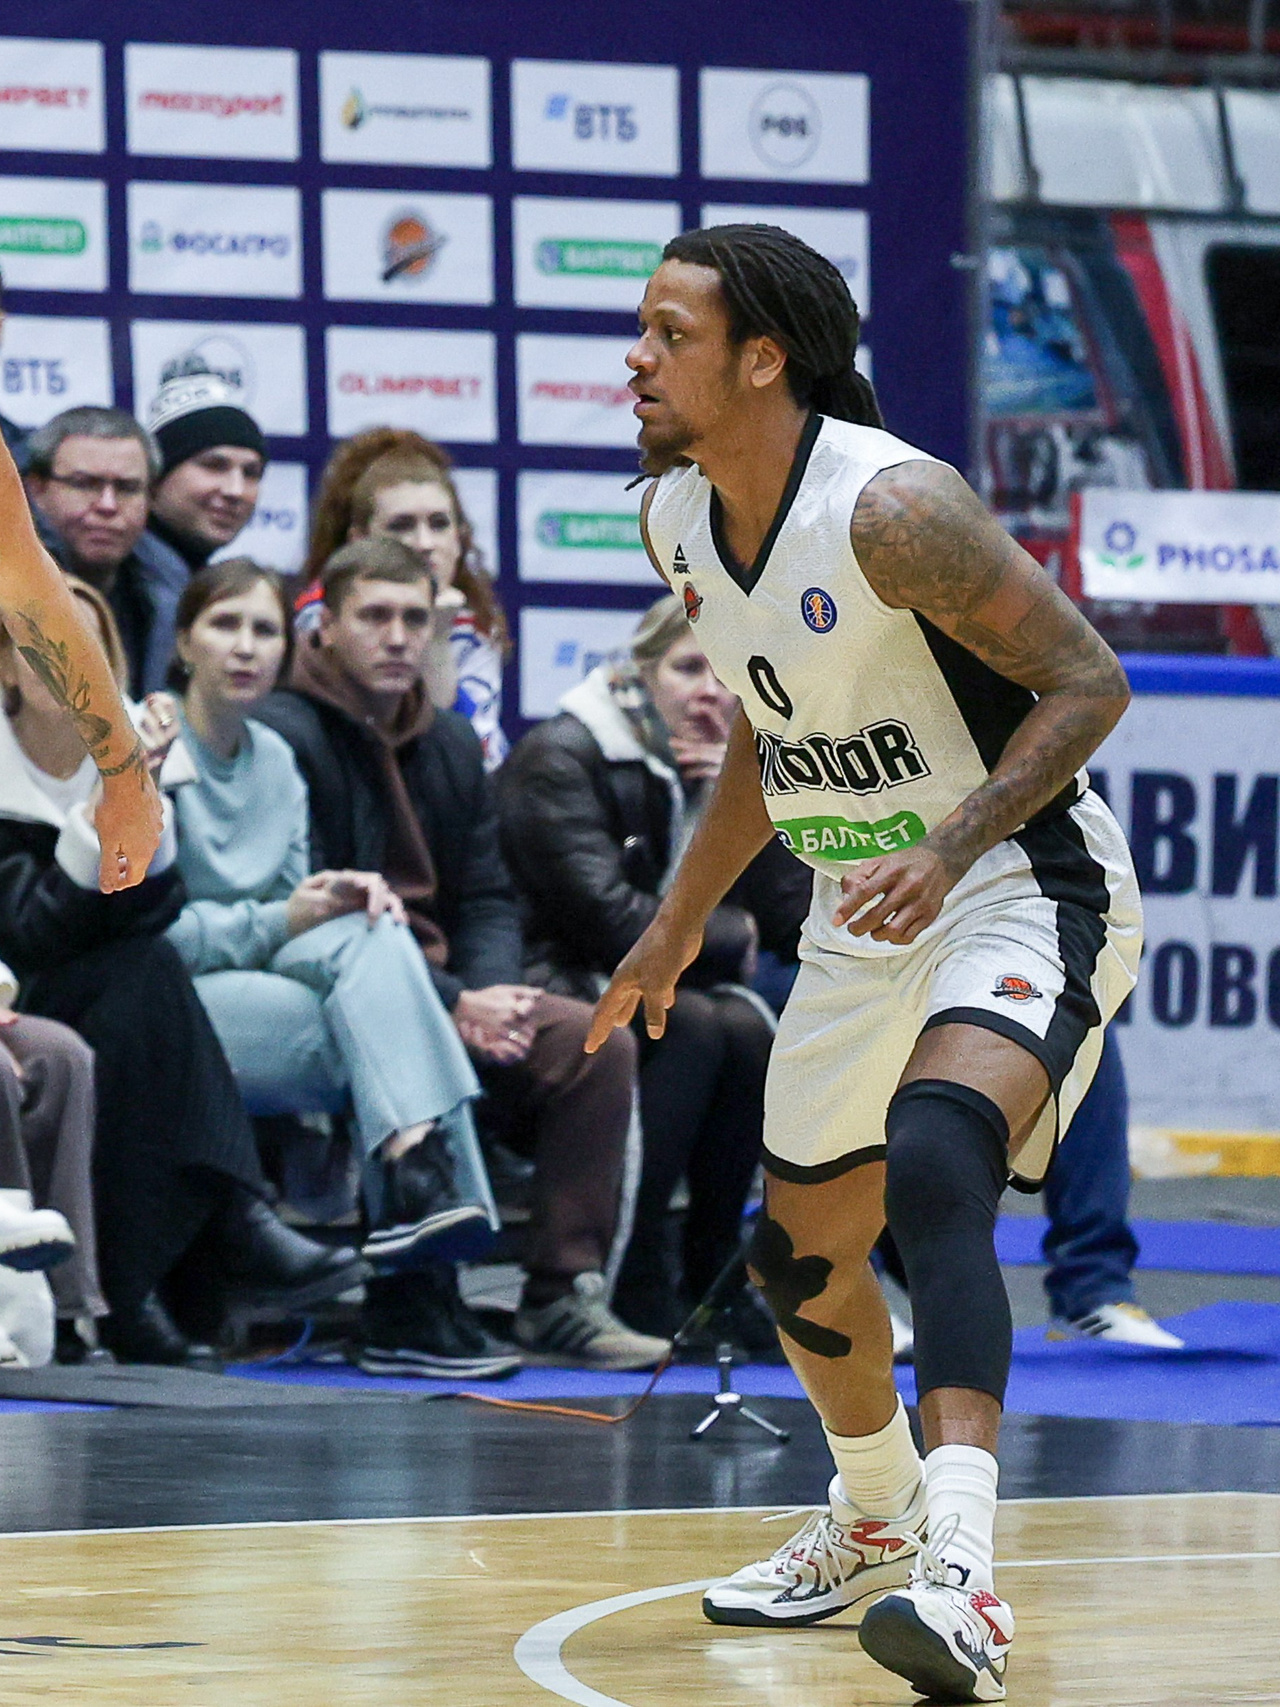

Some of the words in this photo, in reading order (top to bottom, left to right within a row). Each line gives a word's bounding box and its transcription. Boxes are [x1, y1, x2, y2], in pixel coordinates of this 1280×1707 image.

[573, 104, 639, 142] ВТБ
[3, 357, 68, 396] ВТБ
[747, 655, 794, 721] 0
